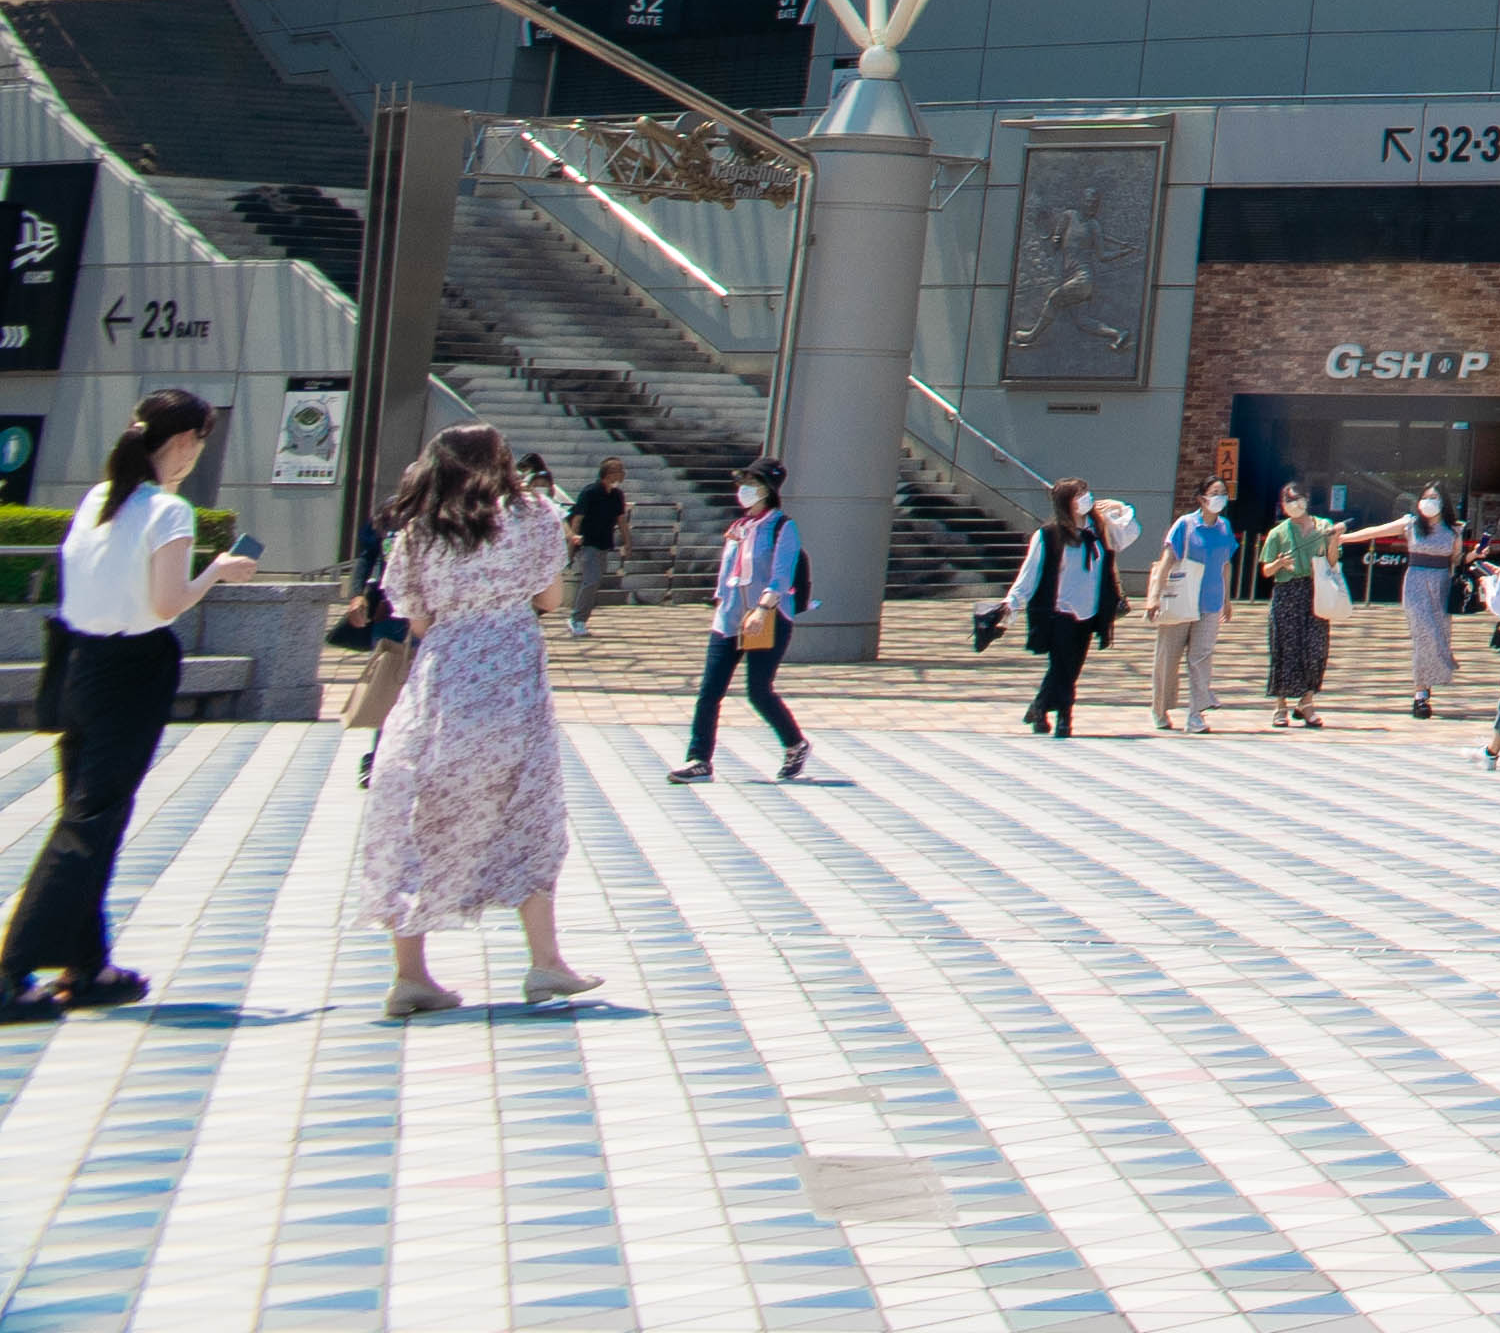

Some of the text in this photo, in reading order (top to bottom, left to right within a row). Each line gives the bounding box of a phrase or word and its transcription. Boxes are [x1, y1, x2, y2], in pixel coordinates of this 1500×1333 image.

[627, 14, 662, 26] GATE
[141, 300, 211, 338] 23 GATE
[1221, 450, 1235, 481] 入口
